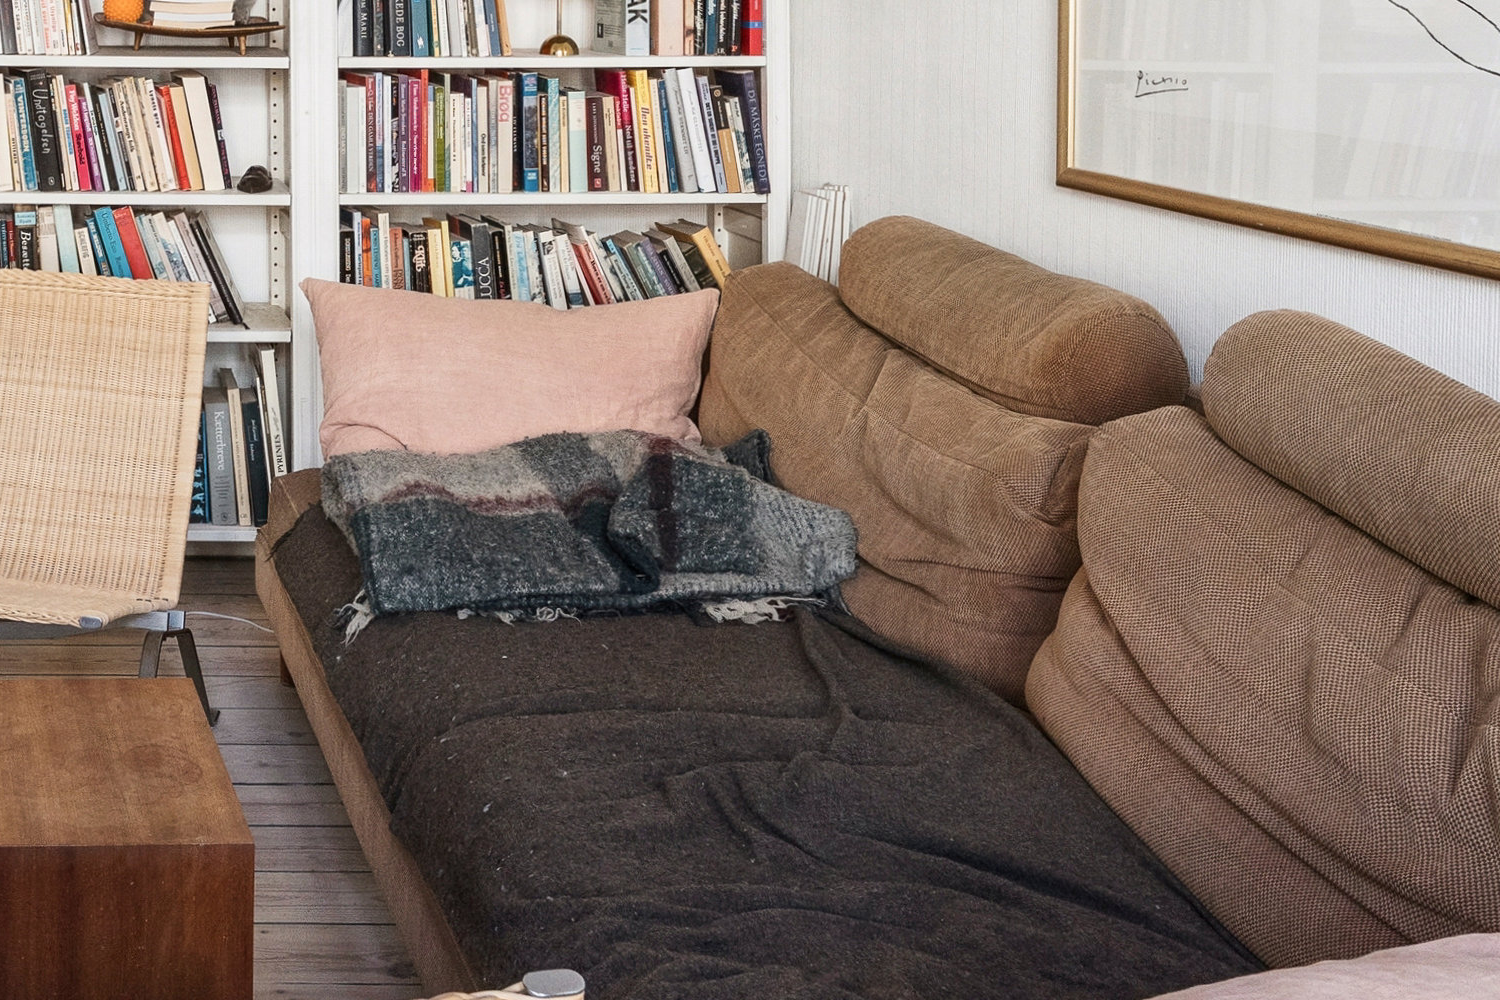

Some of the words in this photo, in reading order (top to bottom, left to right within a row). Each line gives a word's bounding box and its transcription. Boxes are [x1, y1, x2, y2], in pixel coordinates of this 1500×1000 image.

[397, 26, 405, 47] BOG
[748, 89, 756, 102] DE
[32, 89, 53, 154] Undtagelsen
[71, 103, 80, 131] Weldon
[641, 107, 650, 125] Den
[749, 107, 761, 139] MÅSKE
[591, 145, 602, 173] Signe
[643, 128, 653, 170] ukendte
[755, 143, 768, 183] EGNEDE
[627, 151, 636, 183] hundene
[101, 213, 114, 240] Umberto
[77, 231, 89, 259] SCHERFIG
[413, 245, 425, 272] Klit
[478, 257, 491, 299] UCCA
[214, 411, 226, 471] Kætterbreve
